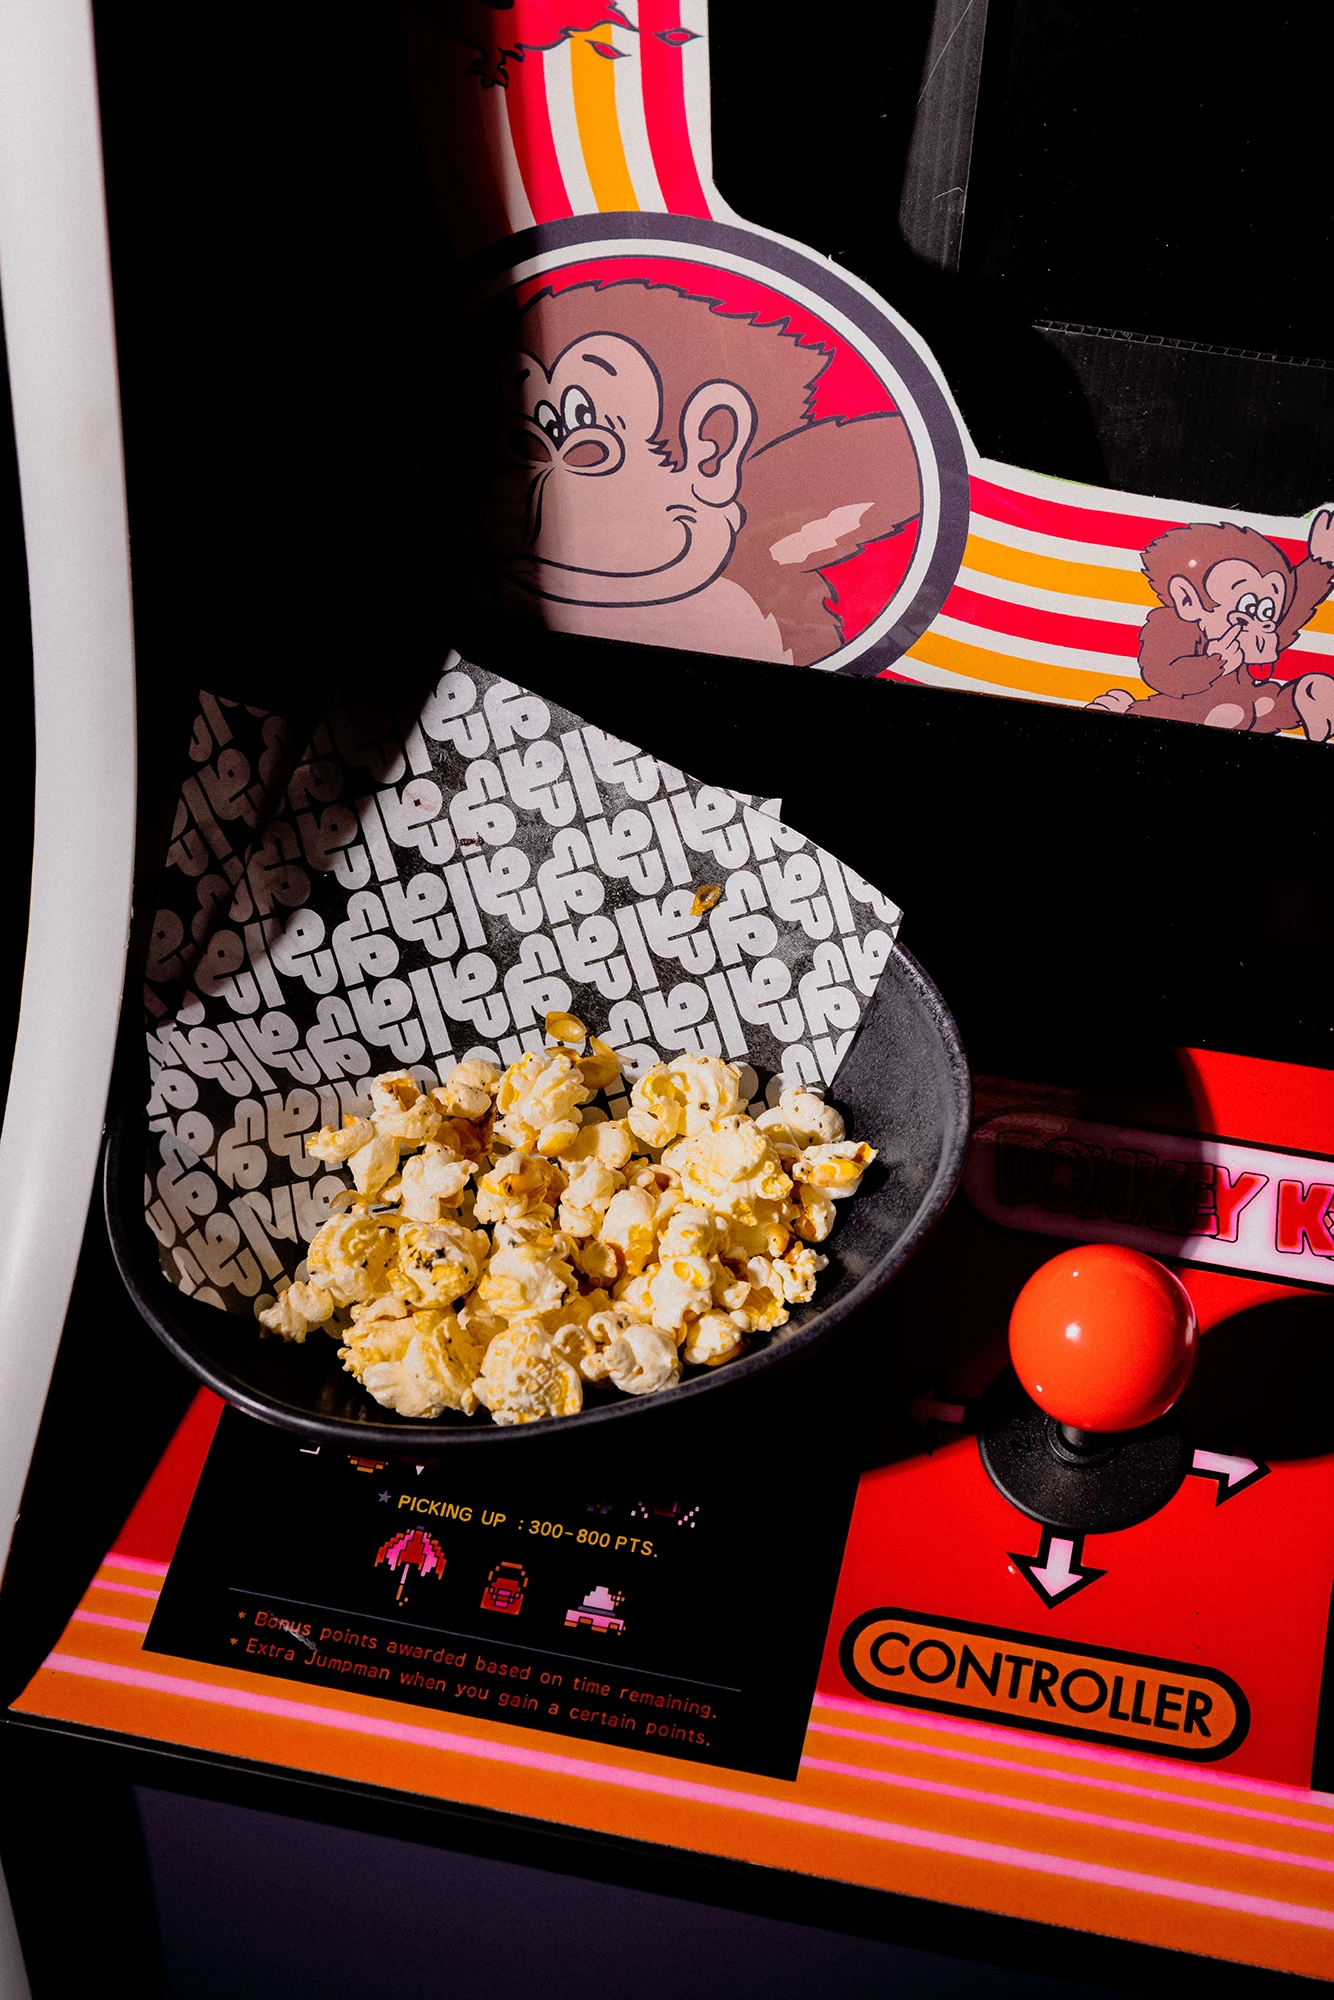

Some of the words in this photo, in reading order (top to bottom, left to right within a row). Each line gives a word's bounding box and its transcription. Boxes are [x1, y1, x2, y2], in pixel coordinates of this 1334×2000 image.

[397, 1494, 473, 1522] PICKING
[481, 1509, 507, 1527] UP
[614, 1535, 658, 1558] PTS.
[245, 1637, 295, 1662] Extra
[304, 1651, 391, 1681] Jumpman
[400, 1671, 447, 1692] when
[455, 1683, 490, 1701] you
[498, 1692, 539, 1711] gain
[548, 1702, 559, 1716] a
[569, 1706, 637, 1731] certain
[645, 1721, 711, 1747] points.
[254, 1611, 312, 1636] Bonus
[319, 1627, 378, 1650] points
[386, 1640, 467, 1667] awarded
[475, 1655, 532, 1681] based
[540, 1671, 563, 1687] on
[573, 1676, 611, 1697] time
[619, 1687, 717, 1719] remaining.
[869, 1631, 1212, 1738] CONTROLLER
